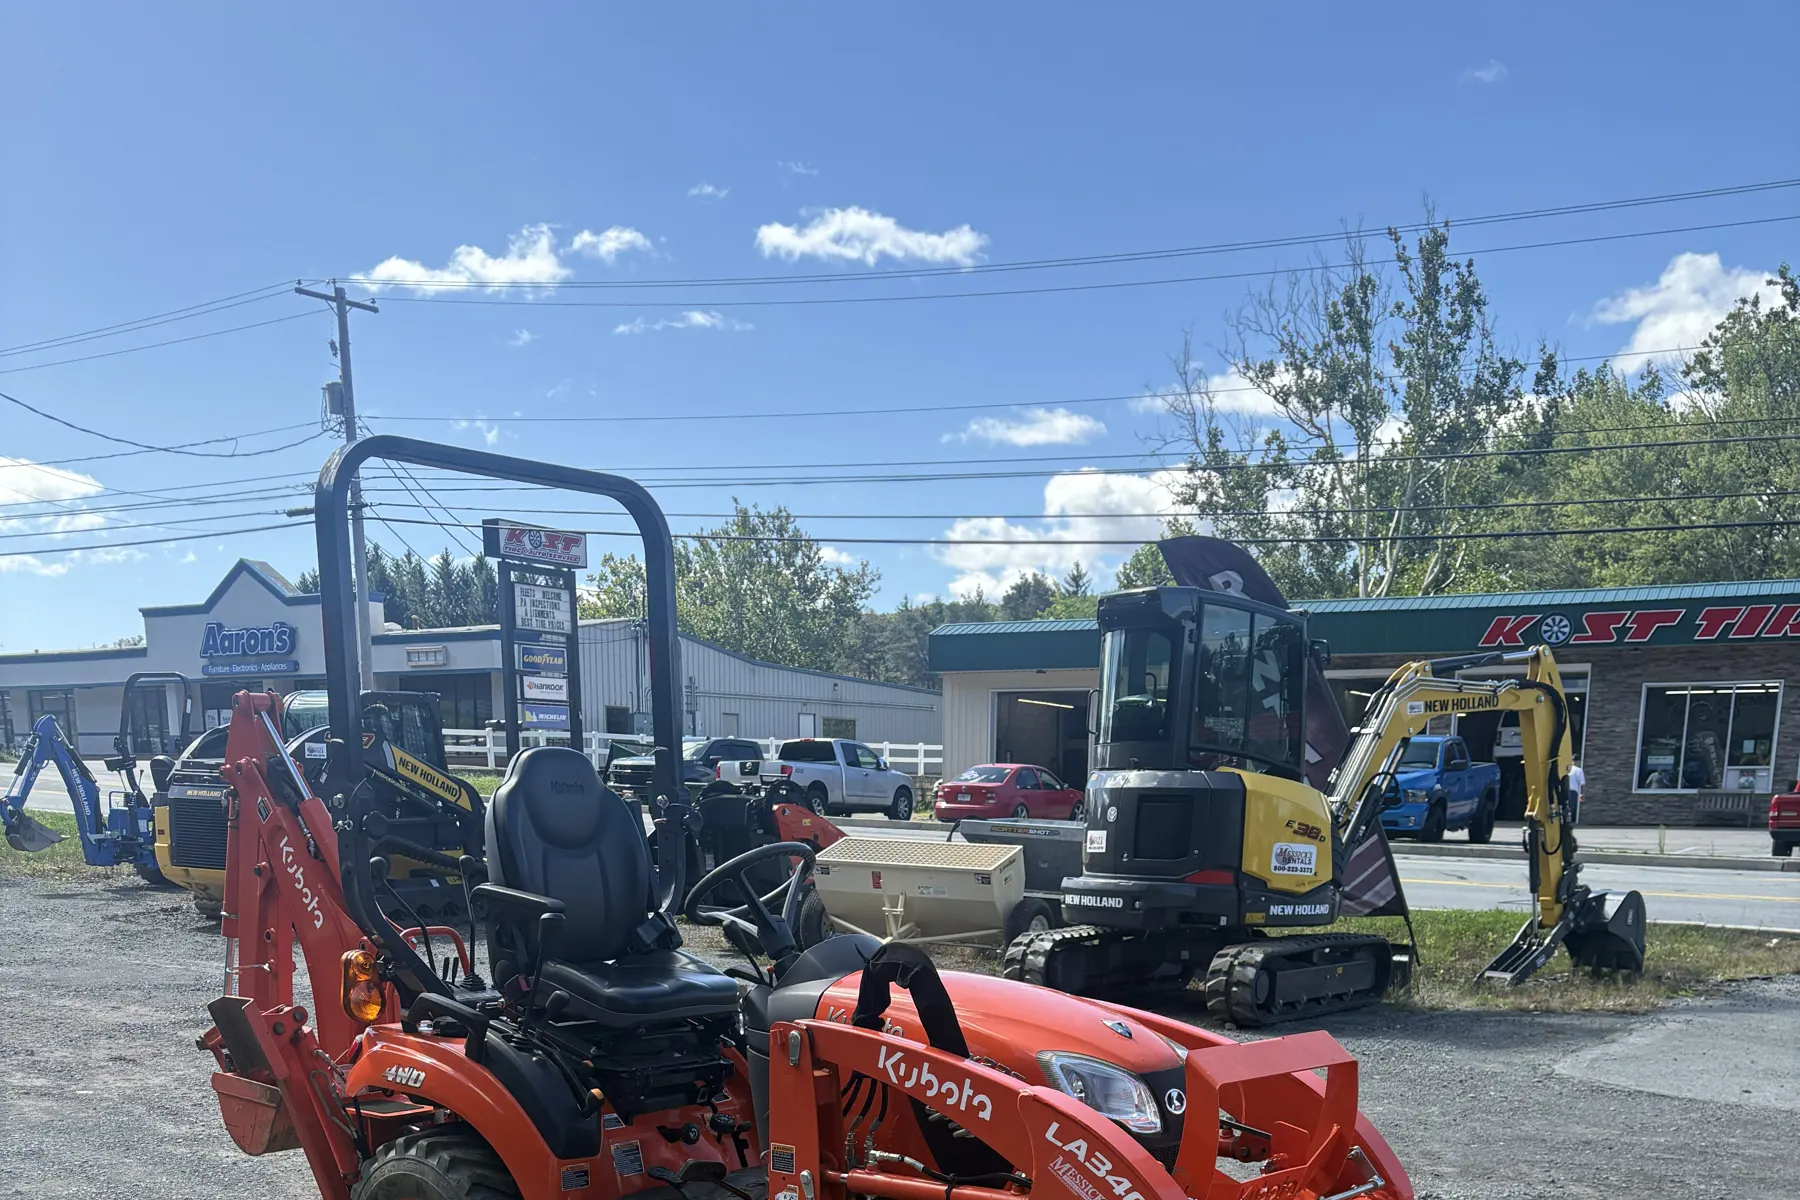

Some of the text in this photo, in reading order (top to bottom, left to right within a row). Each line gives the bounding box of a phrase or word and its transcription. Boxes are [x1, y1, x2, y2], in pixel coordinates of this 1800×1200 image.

[548, 553, 579, 562] SERVICE
[520, 587, 562, 601] FLEETS WELCOME
[520, 597, 560, 610] PA INSPECTIONS
[535, 618, 546, 629] TIRE
[548, 620, 565, 630] PRICES
[201, 623, 291, 657] Aaron's
[523, 654, 563, 665] GOODYEAR
[208, 662, 287, 673] Furniture Electronics Appliances
[1425, 699, 1449, 713] NEW
[1451, 695, 1499, 711] HOLLAND
[538, 713, 566, 721] MICHELIN
[398, 756, 458, 798] NEW HOLLAND
[71, 768, 91, 816] NEW HOLLAND
[198, 789, 221, 797] HOLLAND
[1282, 856, 1312, 866] RENTALS
[280, 836, 324, 929] Kubota
[1065, 893, 1123, 908] NEW HOLLAND
[1269, 904, 1329, 915] NEW HOLLAND
[381, 1064, 426, 1088] 4WD
[877, 1045, 993, 1121] Kubota
